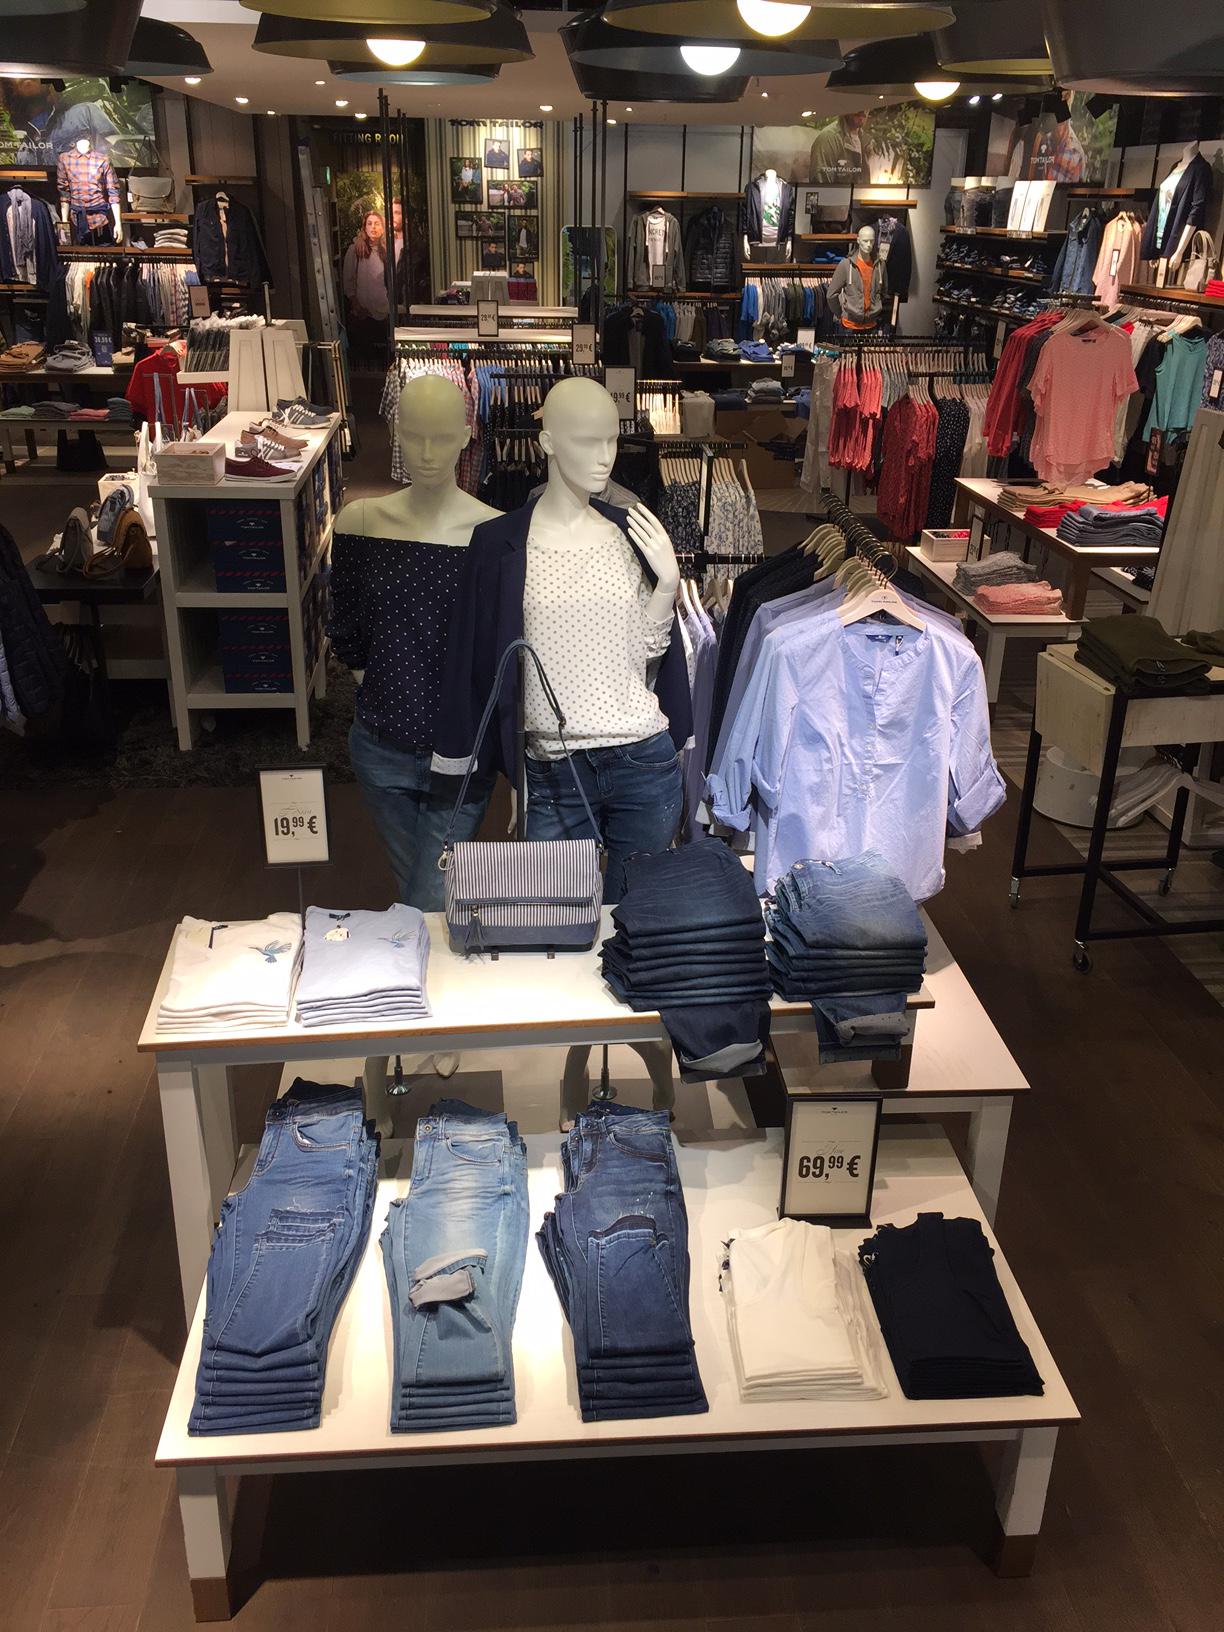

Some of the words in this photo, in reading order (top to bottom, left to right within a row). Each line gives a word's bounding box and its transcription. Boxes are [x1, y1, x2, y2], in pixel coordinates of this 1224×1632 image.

[375, 133, 404, 144] RO
[274, 816, 305, 837] 19,99
[307, 815, 319, 835] €
[798, 1155, 845, 1181] 69,99
[846, 1155, 862, 1178] €
